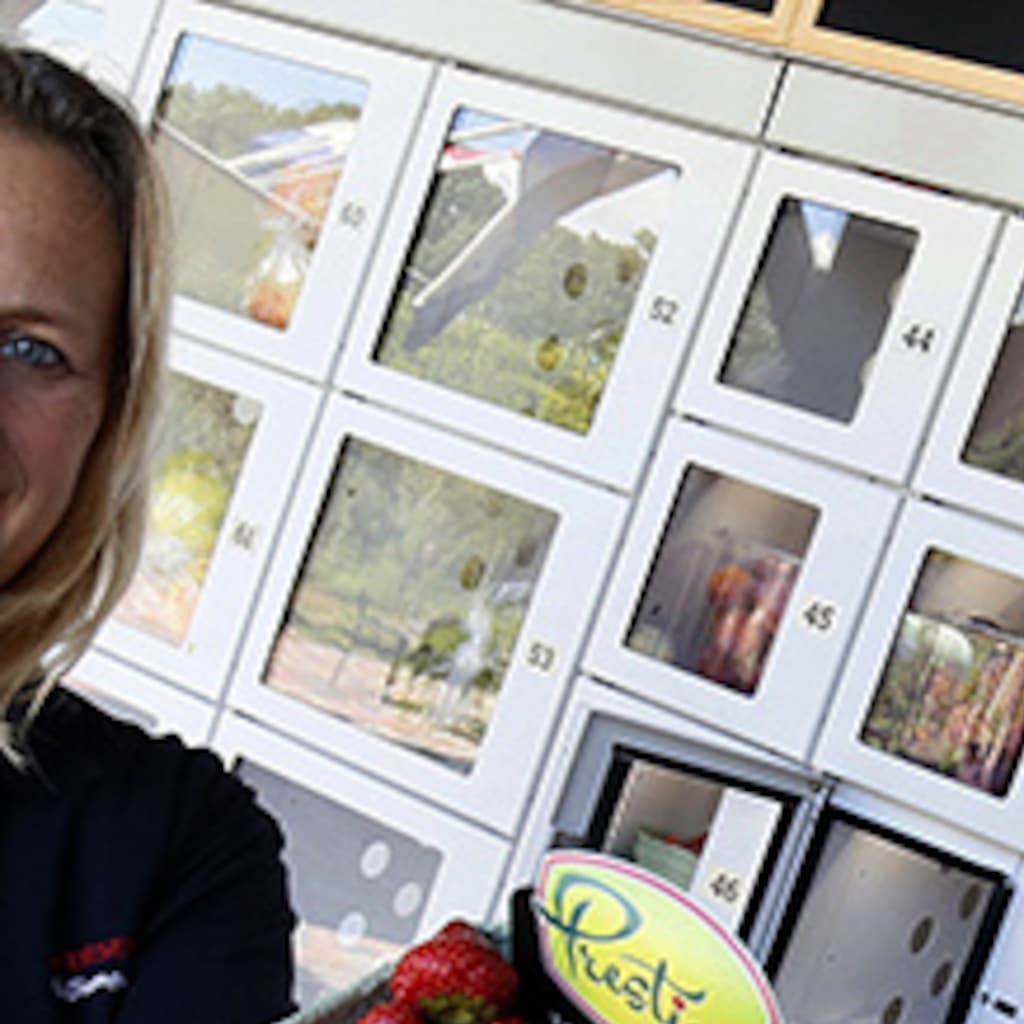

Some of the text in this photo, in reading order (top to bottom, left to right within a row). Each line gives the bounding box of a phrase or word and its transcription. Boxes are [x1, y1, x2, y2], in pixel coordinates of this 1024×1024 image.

[650, 296, 678, 325] 52
[901, 325, 934, 353] 44
[803, 602, 836, 631] 45
[526, 642, 556, 671] 53
[710, 873, 740, 903] 46
